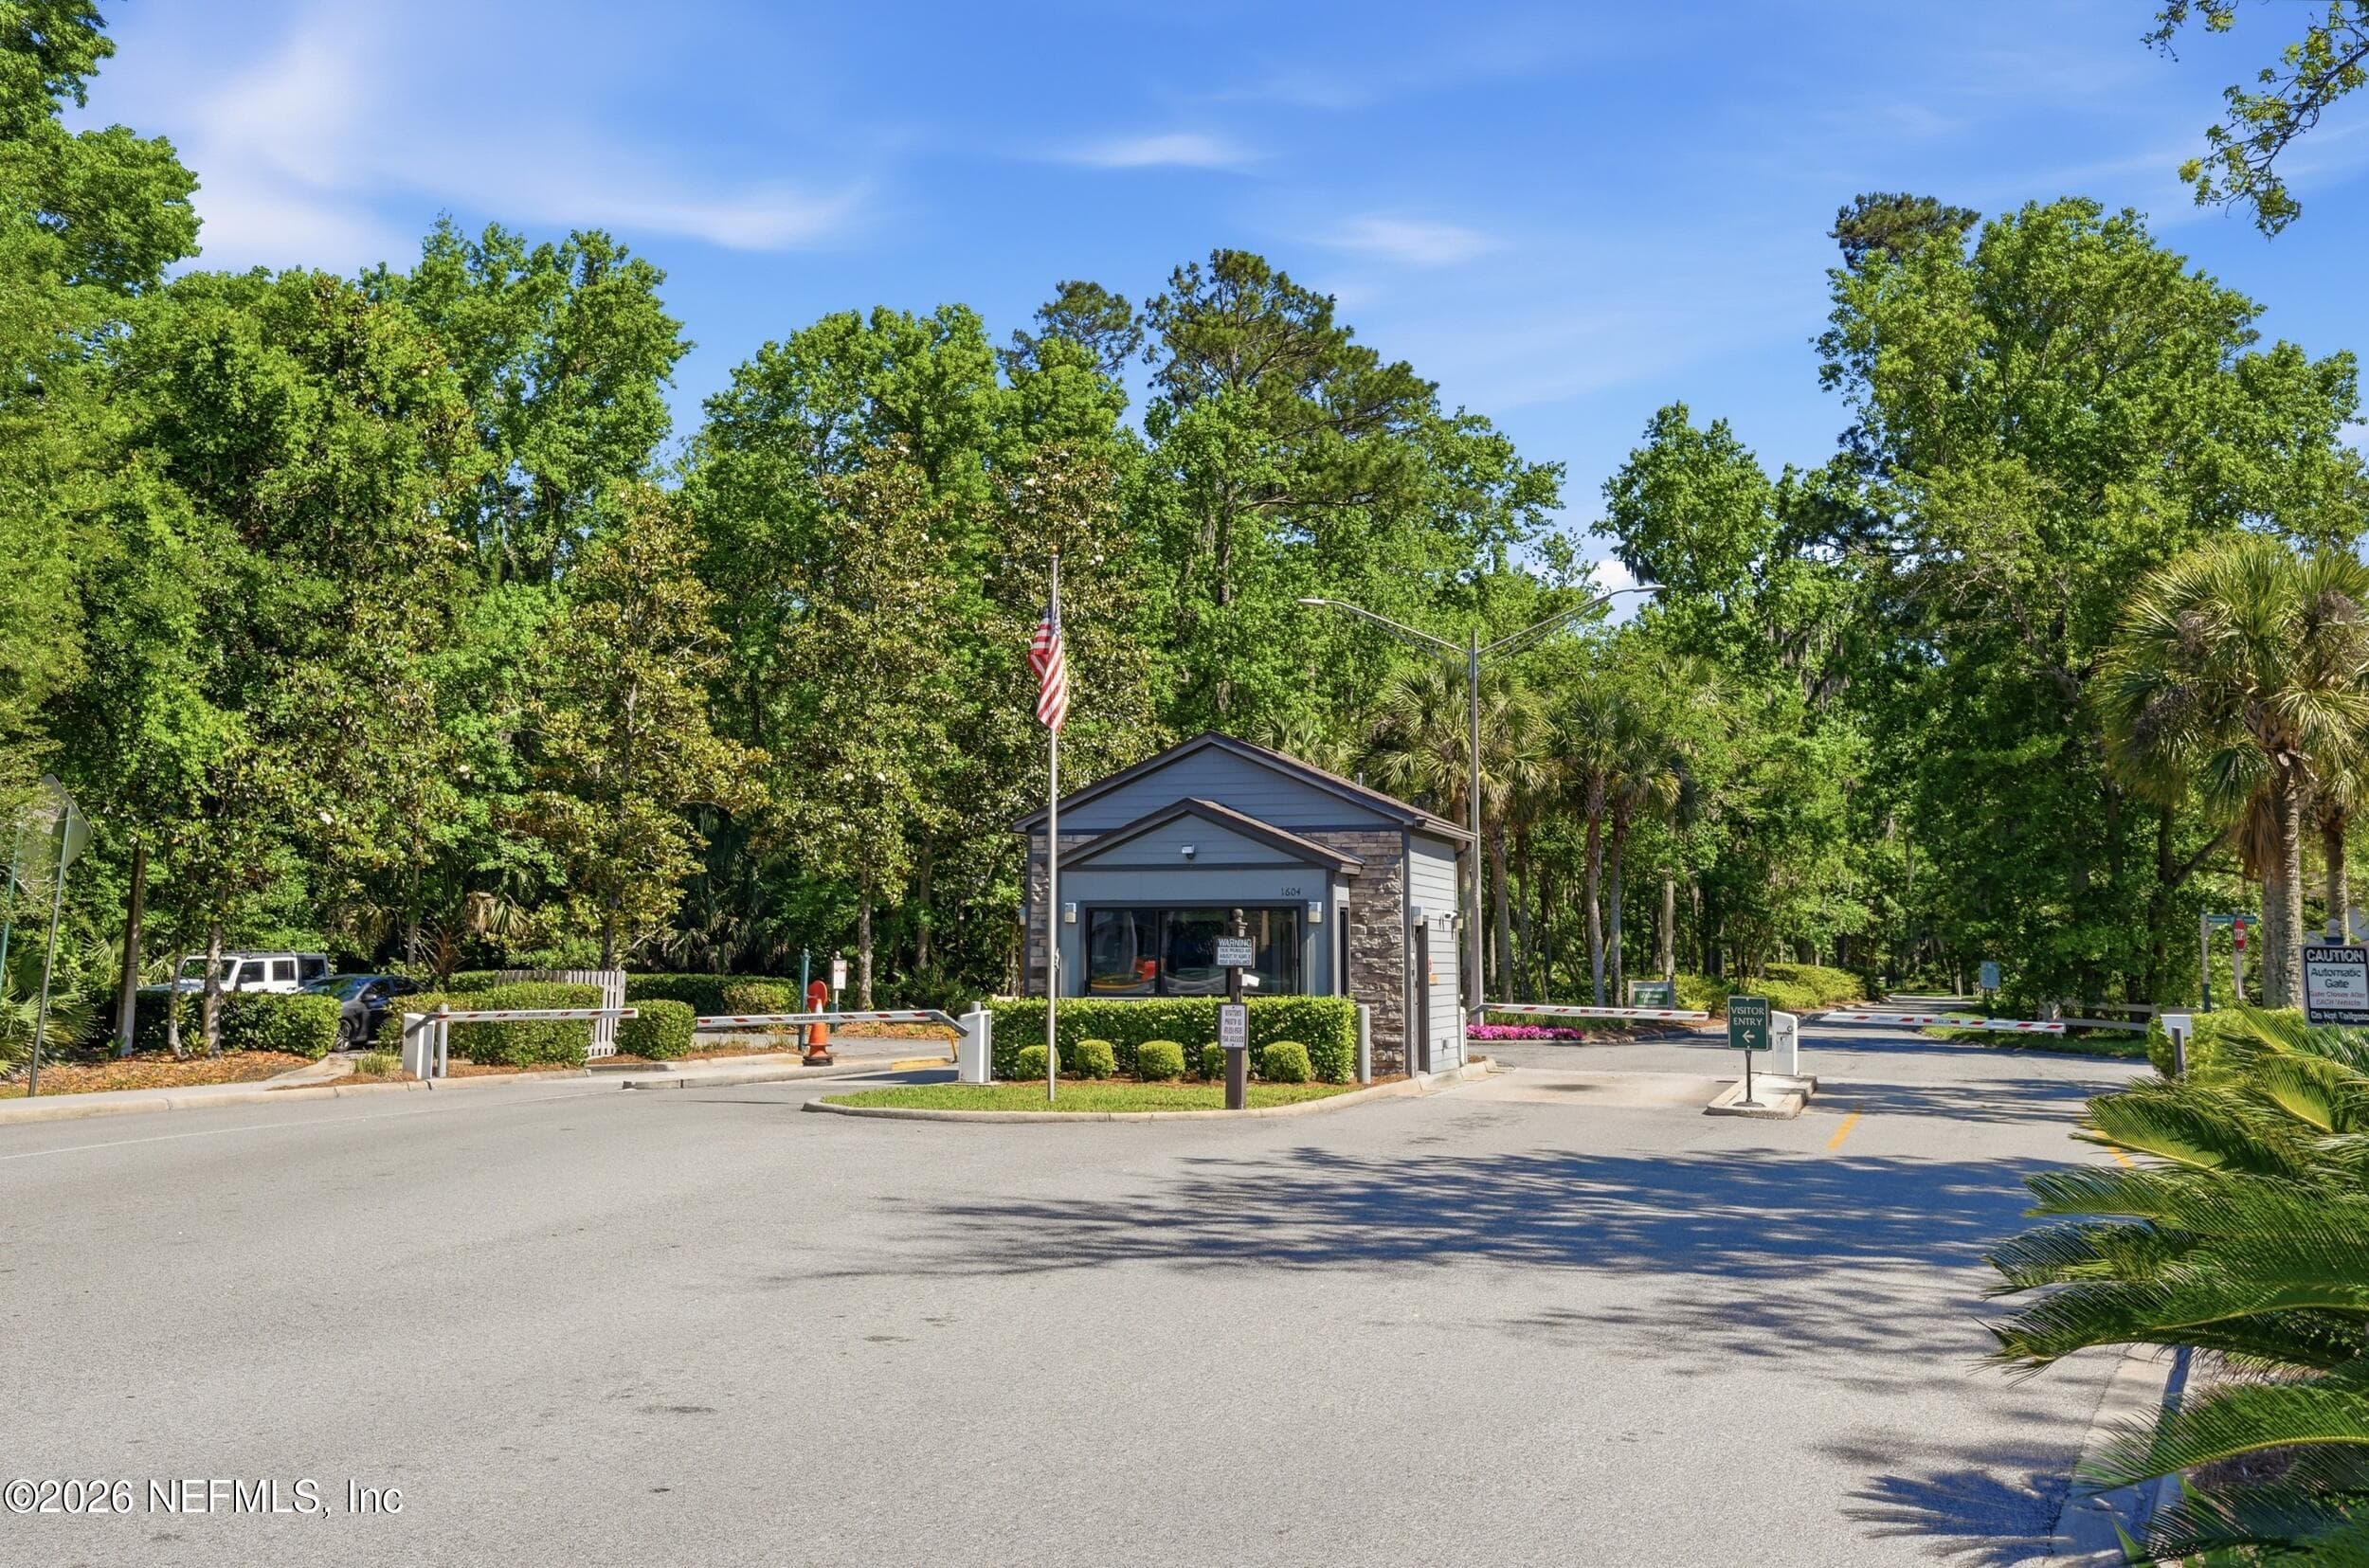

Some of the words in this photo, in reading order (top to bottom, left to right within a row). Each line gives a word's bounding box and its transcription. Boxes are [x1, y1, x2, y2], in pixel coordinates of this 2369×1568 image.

[1281, 886, 1301, 896] 1604
[1218, 938, 1252, 946] WARNING
[2306, 948, 2365, 963] CAUTION
[2310, 967, 2361, 978] Automatic
[2324, 979, 2350, 988] Gate
[1730, 1006, 1765, 1016] VISITOR
[1733, 1017, 1763, 1026] ENTRY
